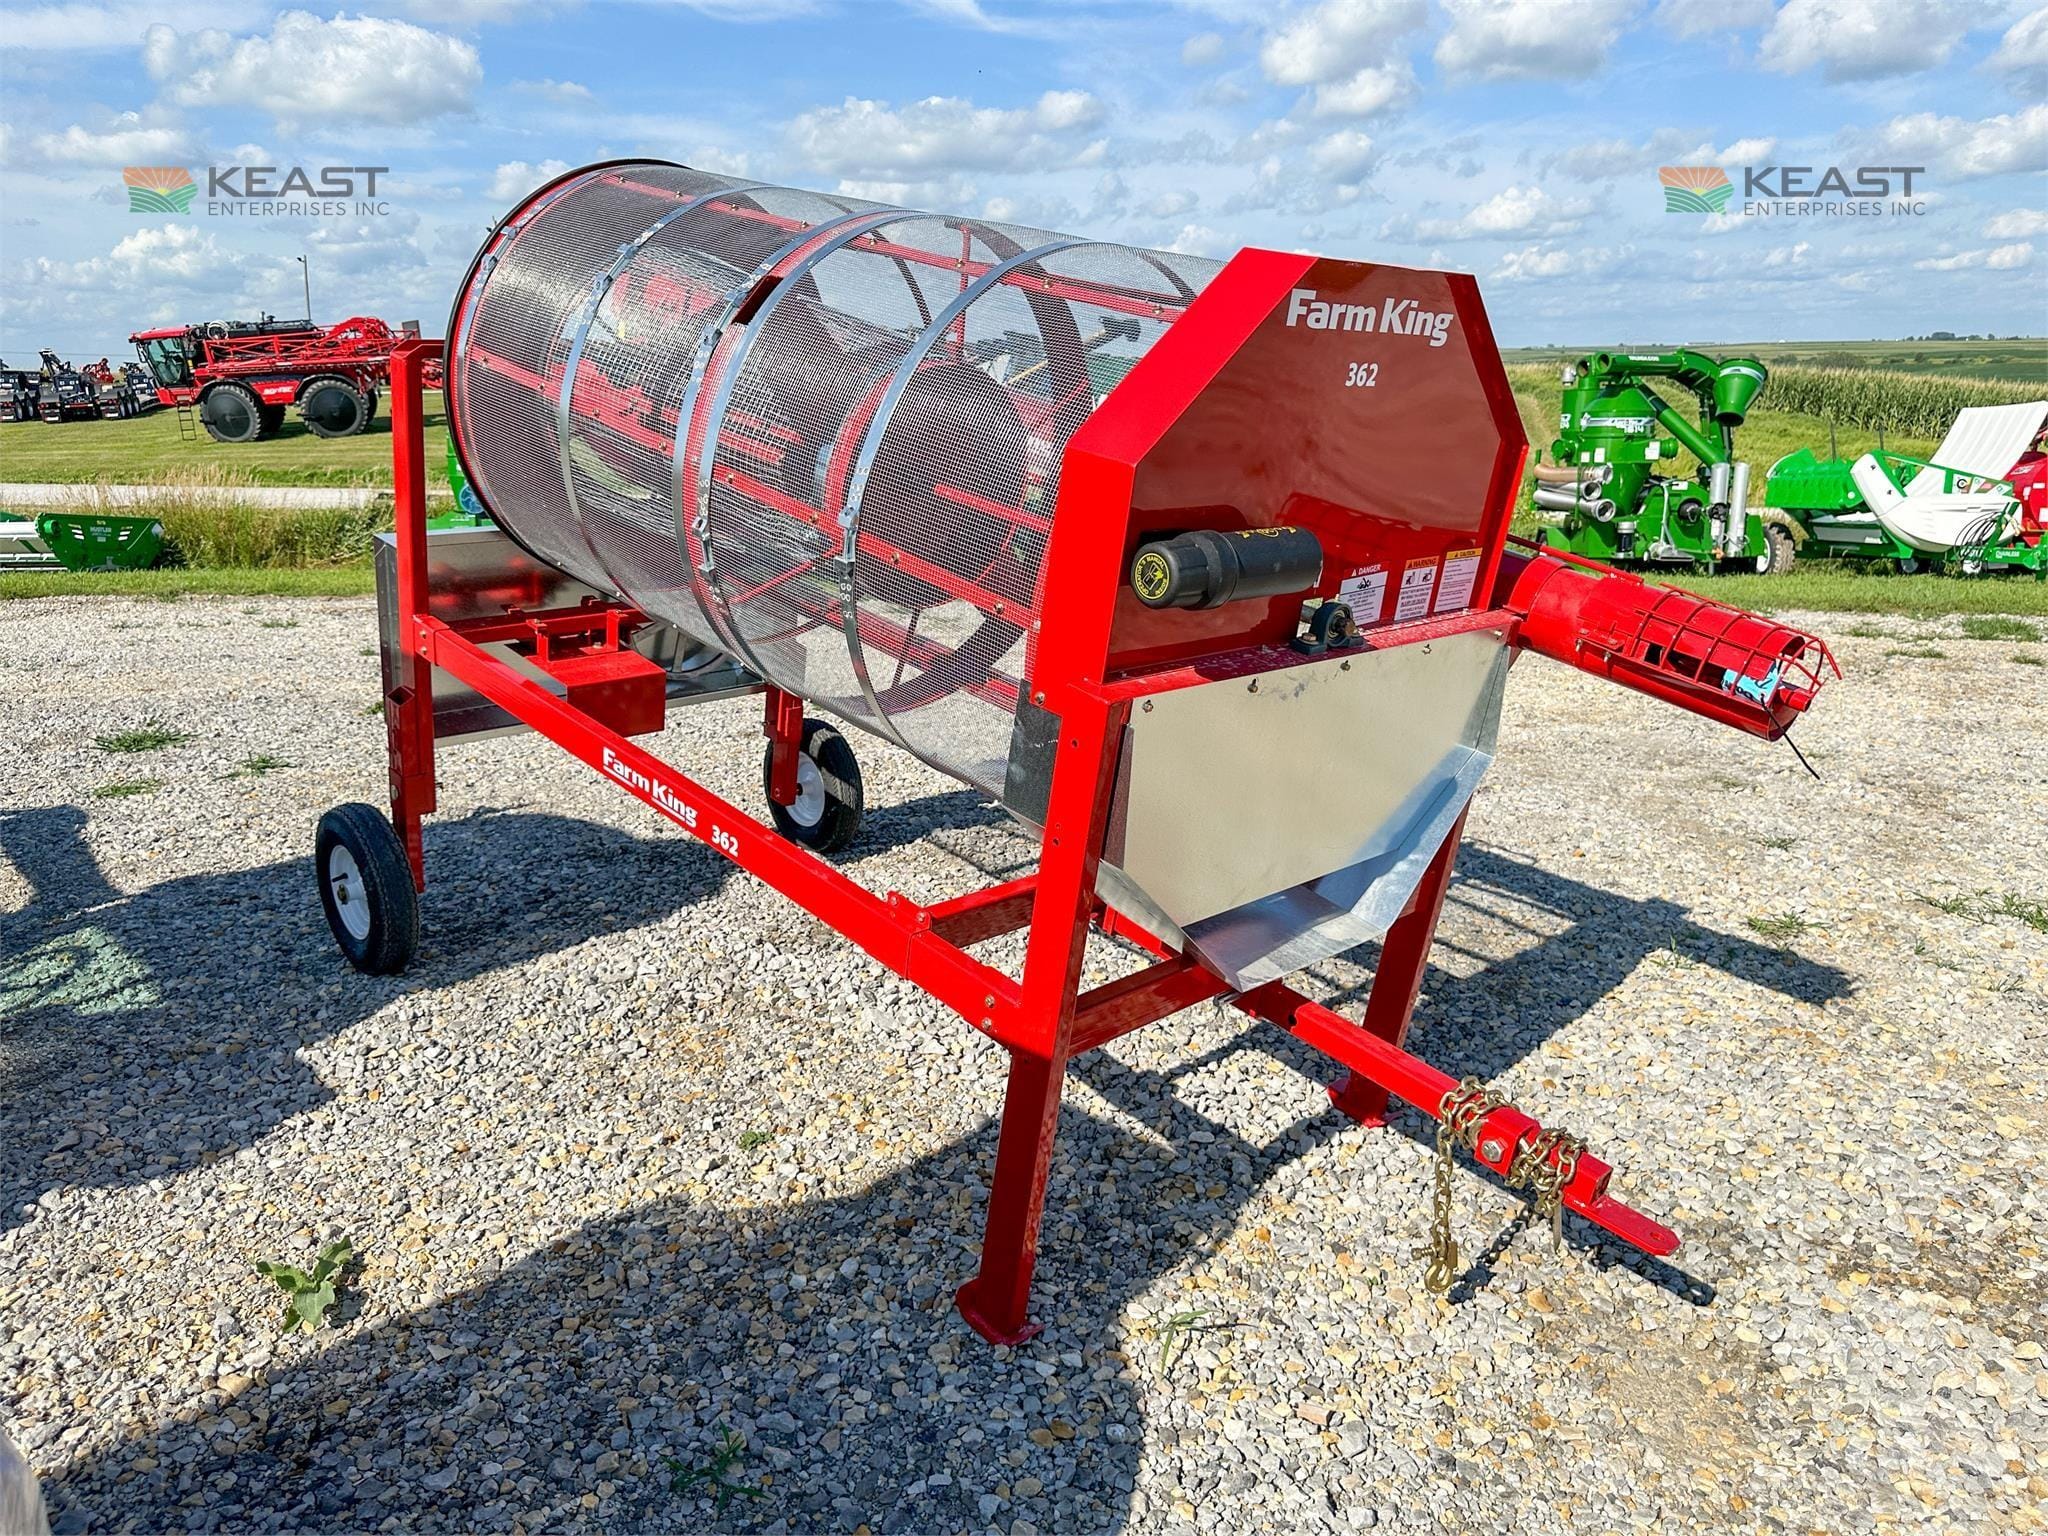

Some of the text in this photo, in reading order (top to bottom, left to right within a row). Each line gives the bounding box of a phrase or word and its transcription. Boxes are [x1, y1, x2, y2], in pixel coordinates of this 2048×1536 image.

[1286, 288, 1454, 347] Farm King
[1345, 362, 1379, 387] 362
[1358, 564, 1382, 575] DANGER
[603, 747, 698, 828] Farm King
[711, 825, 739, 857] 362
